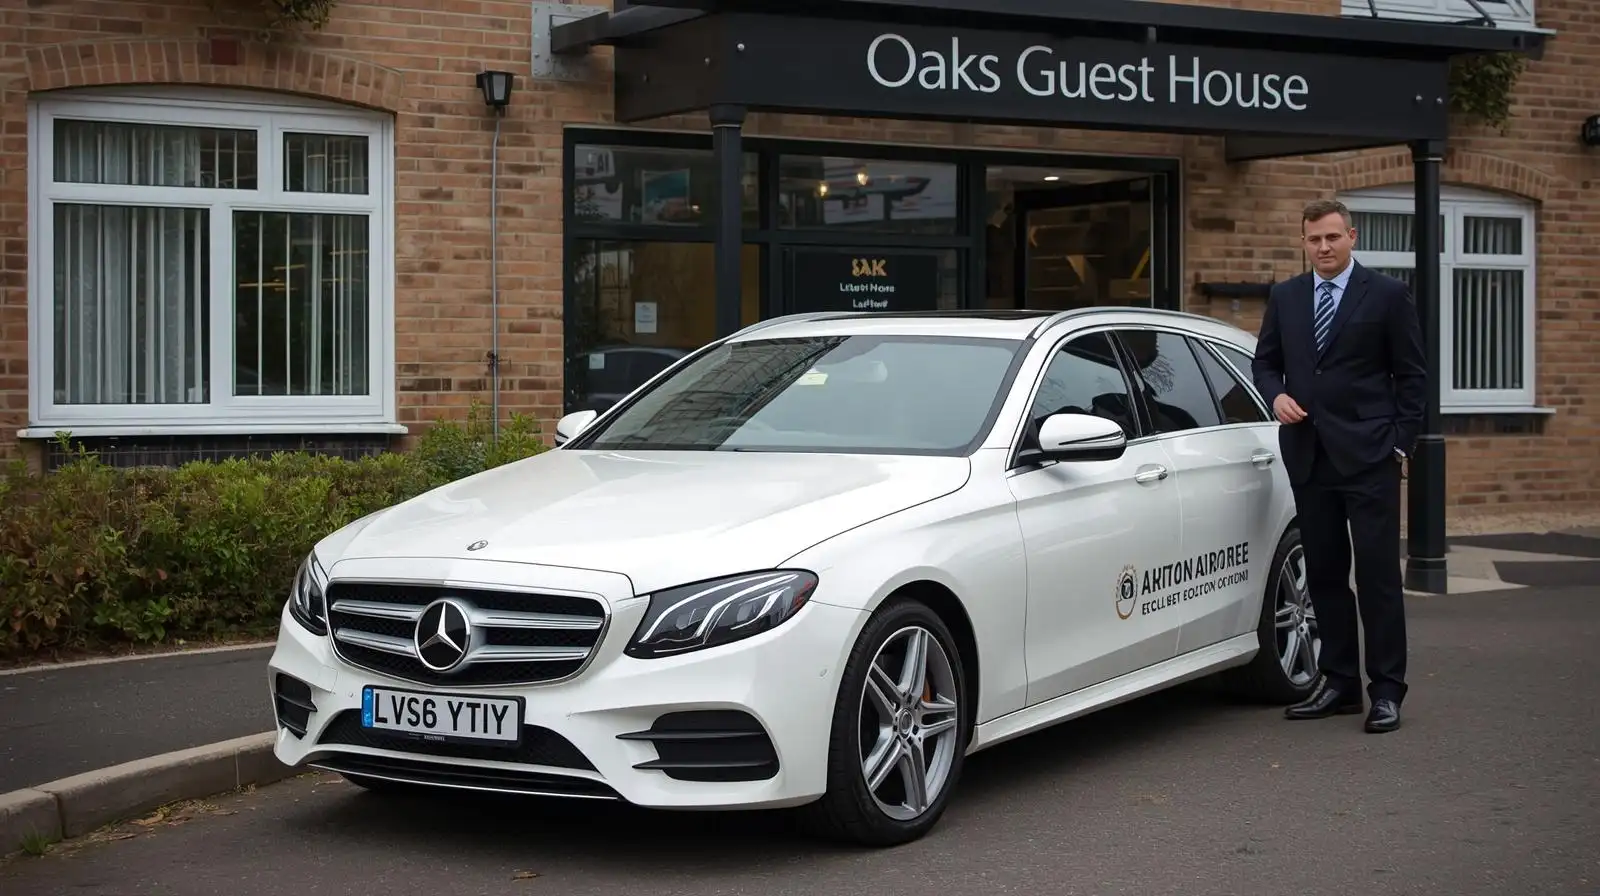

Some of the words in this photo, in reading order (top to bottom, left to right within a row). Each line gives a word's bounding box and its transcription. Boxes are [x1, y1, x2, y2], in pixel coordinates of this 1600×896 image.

[867, 34, 1000, 92] Oaks
[1016, 45, 1155, 102] Guest
[1169, 55, 1309, 111] House
[447, 701, 509, 735] YTIY
